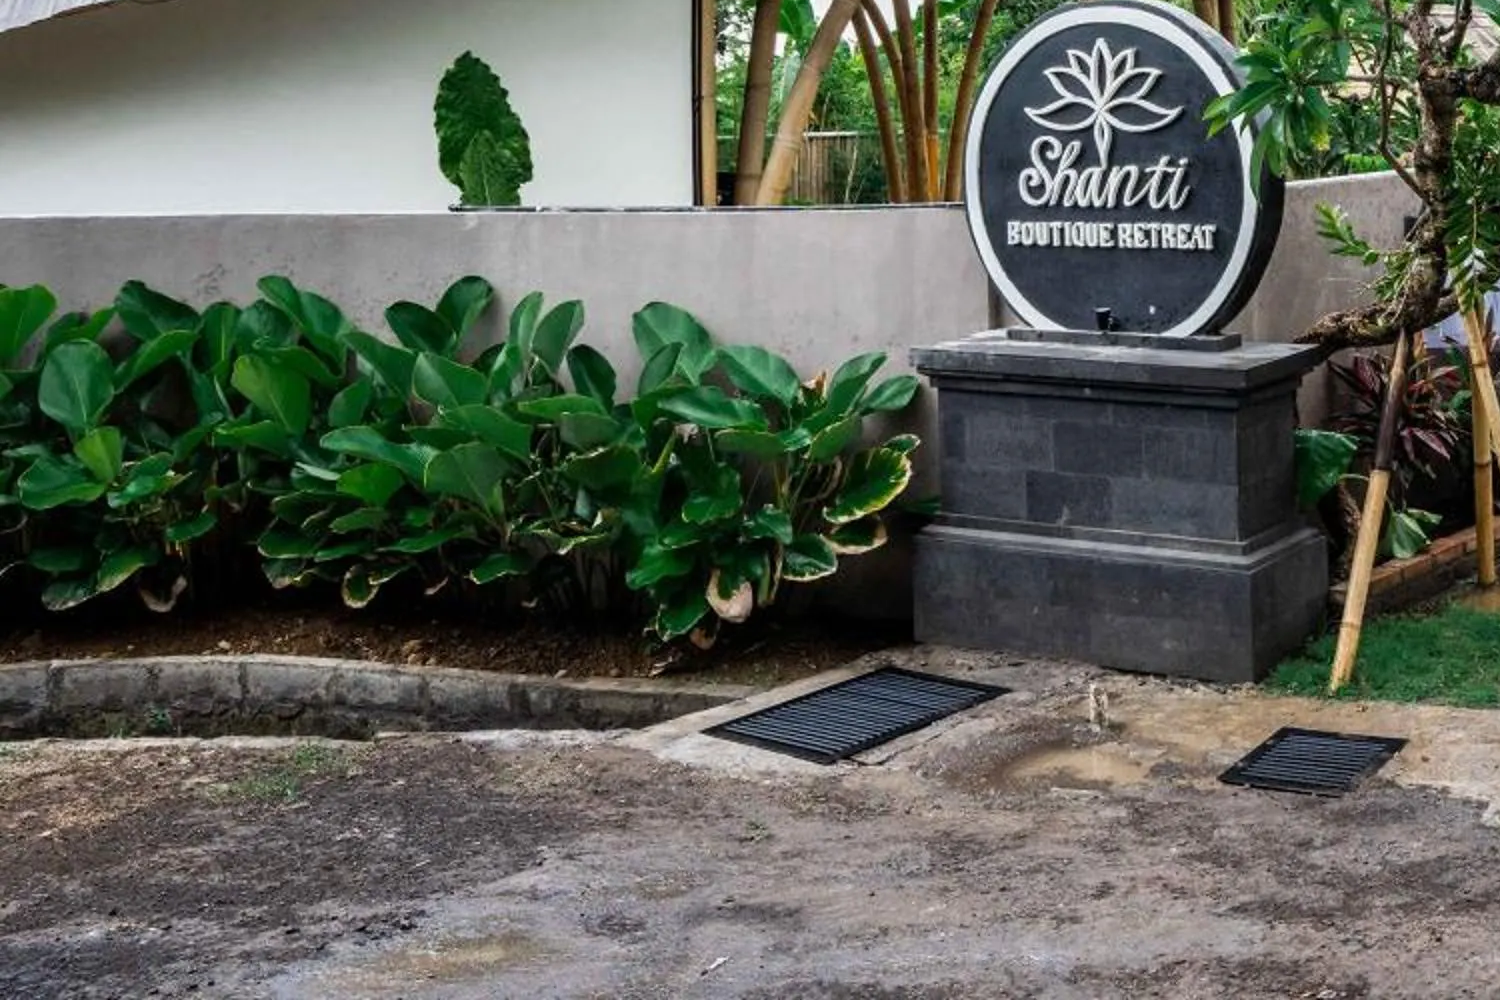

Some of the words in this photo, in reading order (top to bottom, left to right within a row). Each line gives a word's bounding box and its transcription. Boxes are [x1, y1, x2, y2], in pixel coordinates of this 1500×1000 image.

[1018, 134, 1191, 211] Shanti
[1007, 220, 1114, 248] BOUTIQUE
[1118, 221, 1217, 250] RETREAT
